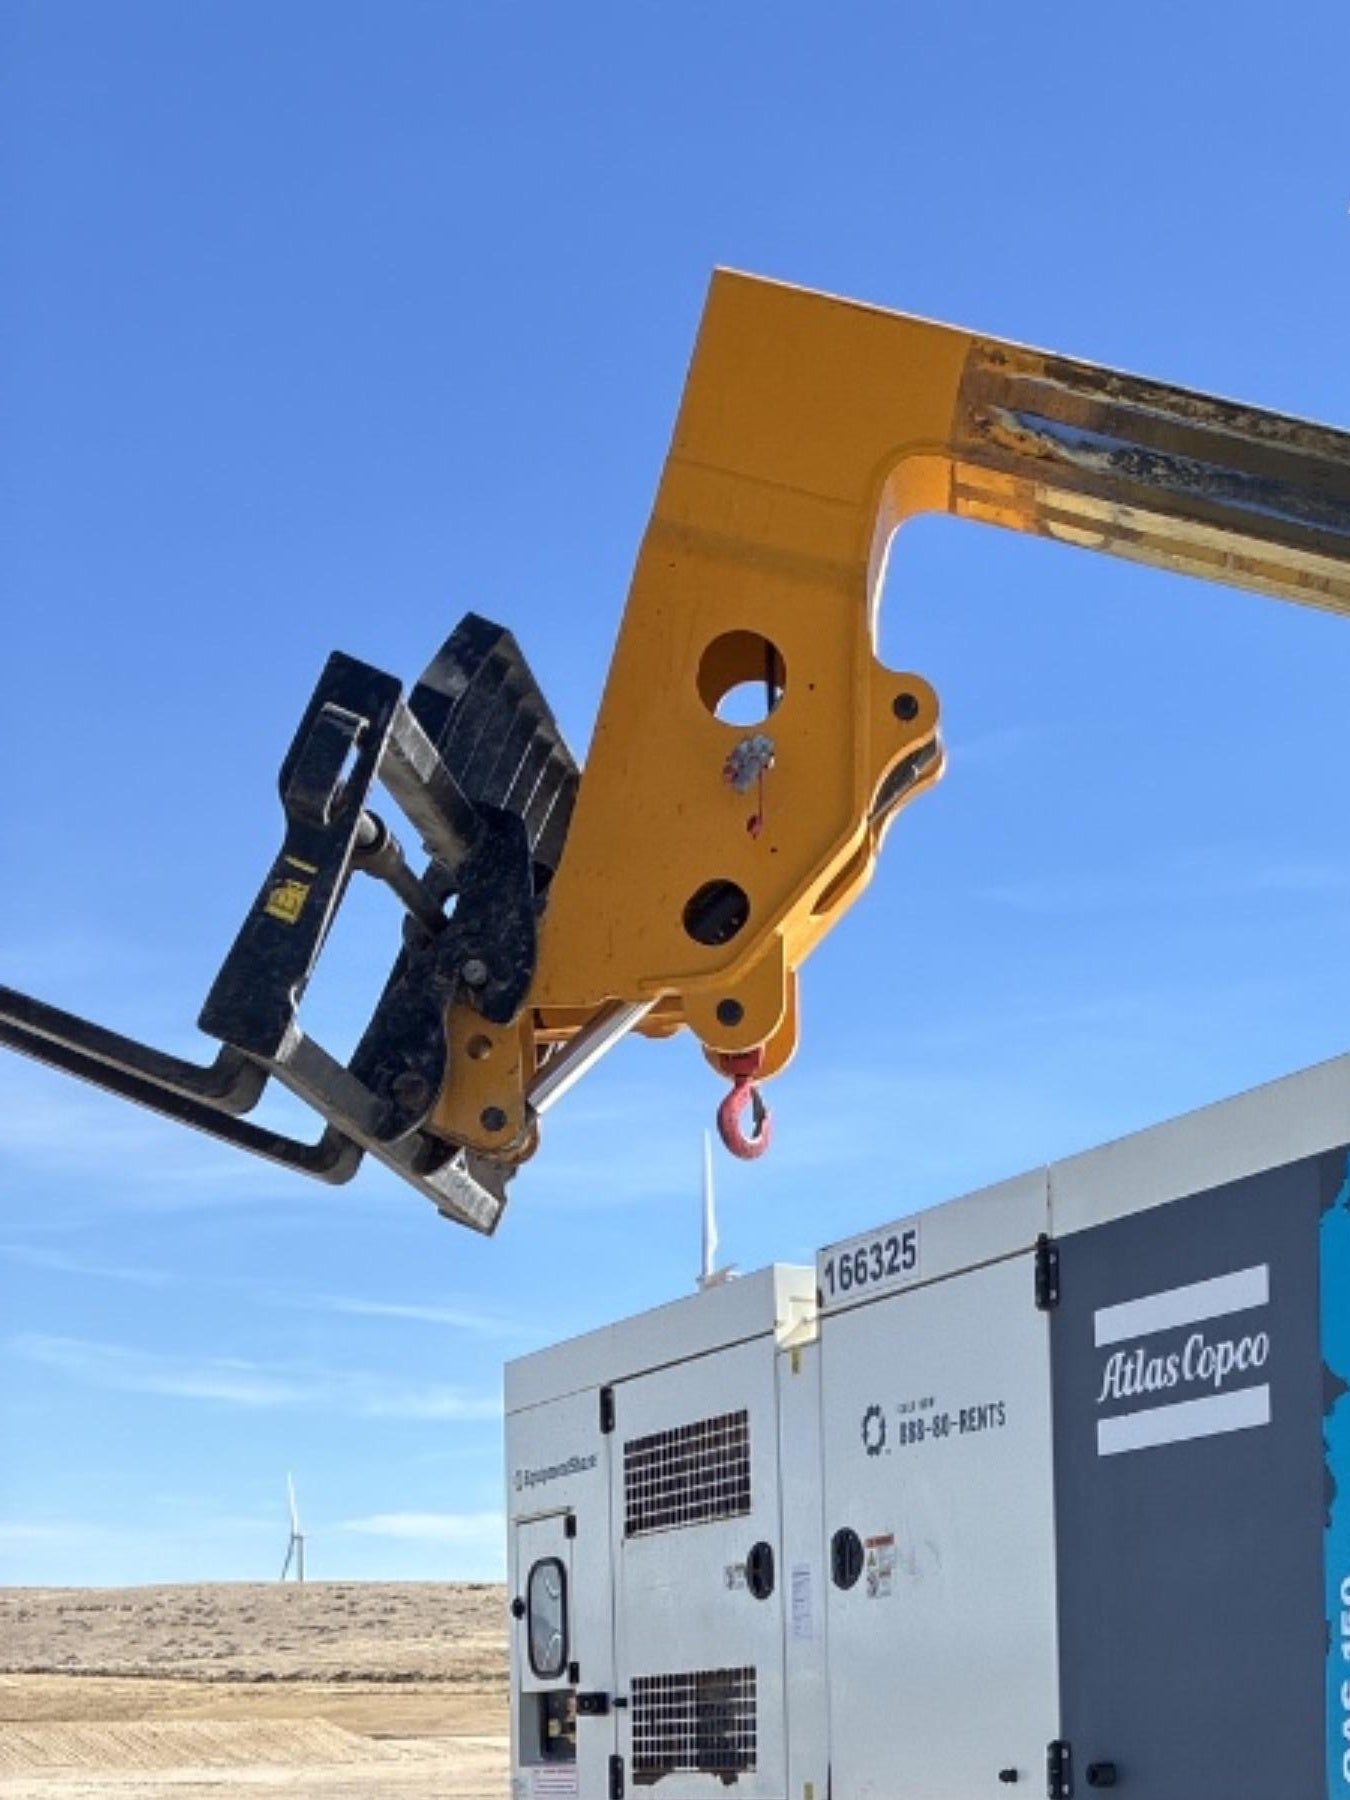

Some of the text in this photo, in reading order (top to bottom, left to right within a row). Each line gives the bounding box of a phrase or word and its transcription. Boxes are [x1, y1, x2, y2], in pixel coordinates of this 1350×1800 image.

[824, 1229, 916, 1297] 166325
[1097, 1331, 1270, 1404] Atlas Copco
